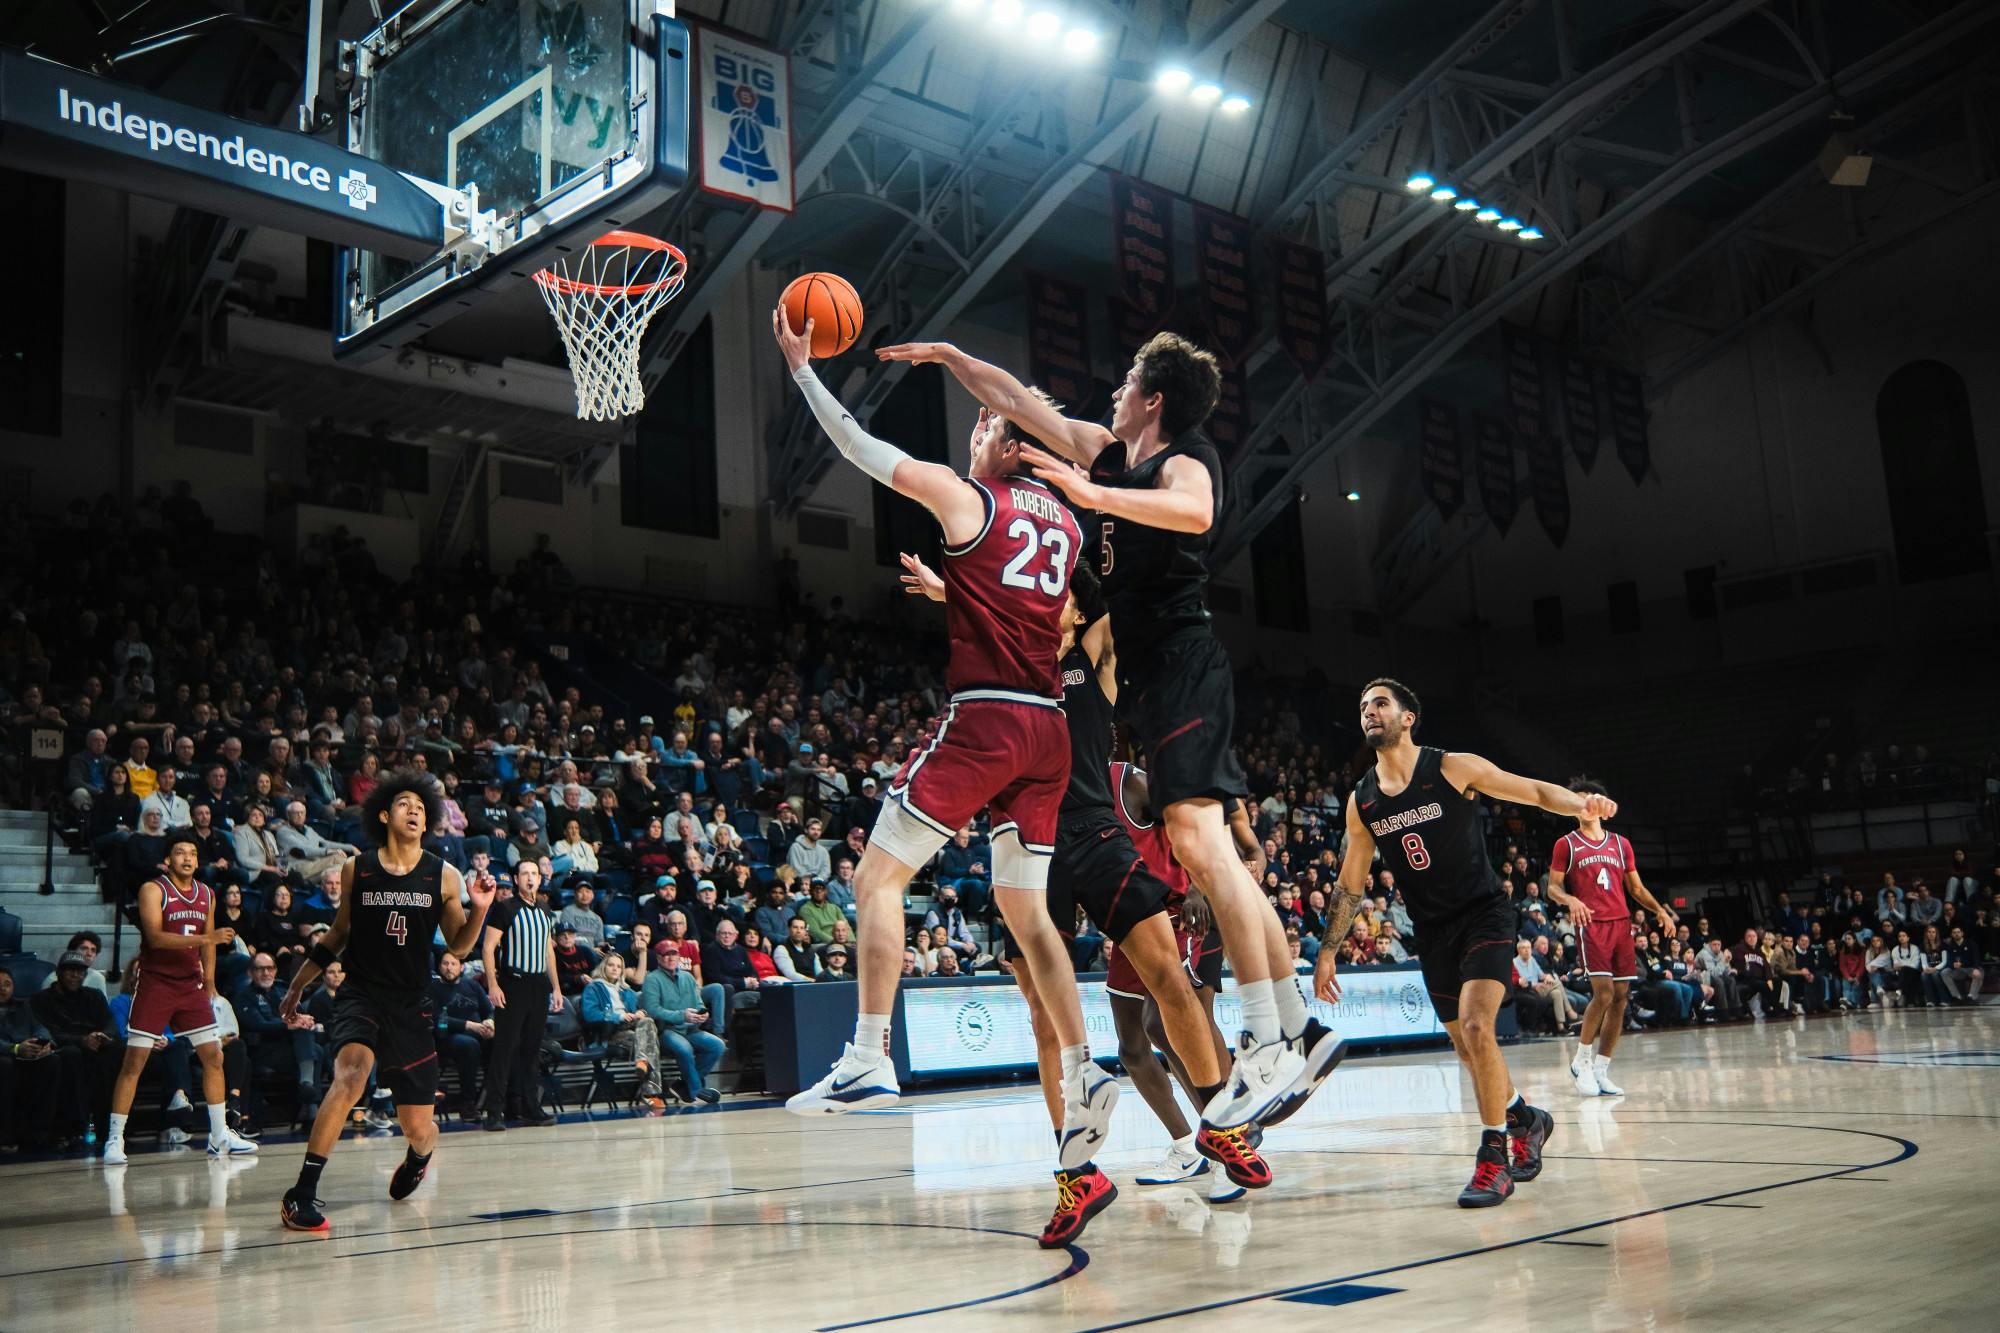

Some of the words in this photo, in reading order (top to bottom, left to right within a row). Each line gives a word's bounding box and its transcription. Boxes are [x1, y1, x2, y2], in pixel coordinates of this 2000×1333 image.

[715, 54, 775, 93] BIG
[59, 88, 331, 191] Independence
[1010, 487, 1062, 524] ROBERTS
[1001, 517, 1070, 597] 23
[1101, 522, 1115, 576] 5
[38, 738, 57, 749] 114
[1370, 803, 1442, 837] HARVARD
[1401, 833, 1430, 871] 8
[1596, 867, 1610, 890] 4
[362, 891, 433, 908] HARVARD
[386, 911, 408, 946] 4
[1332, 997, 1367, 1018] Hotel
[967, 1015, 983, 1037] S
